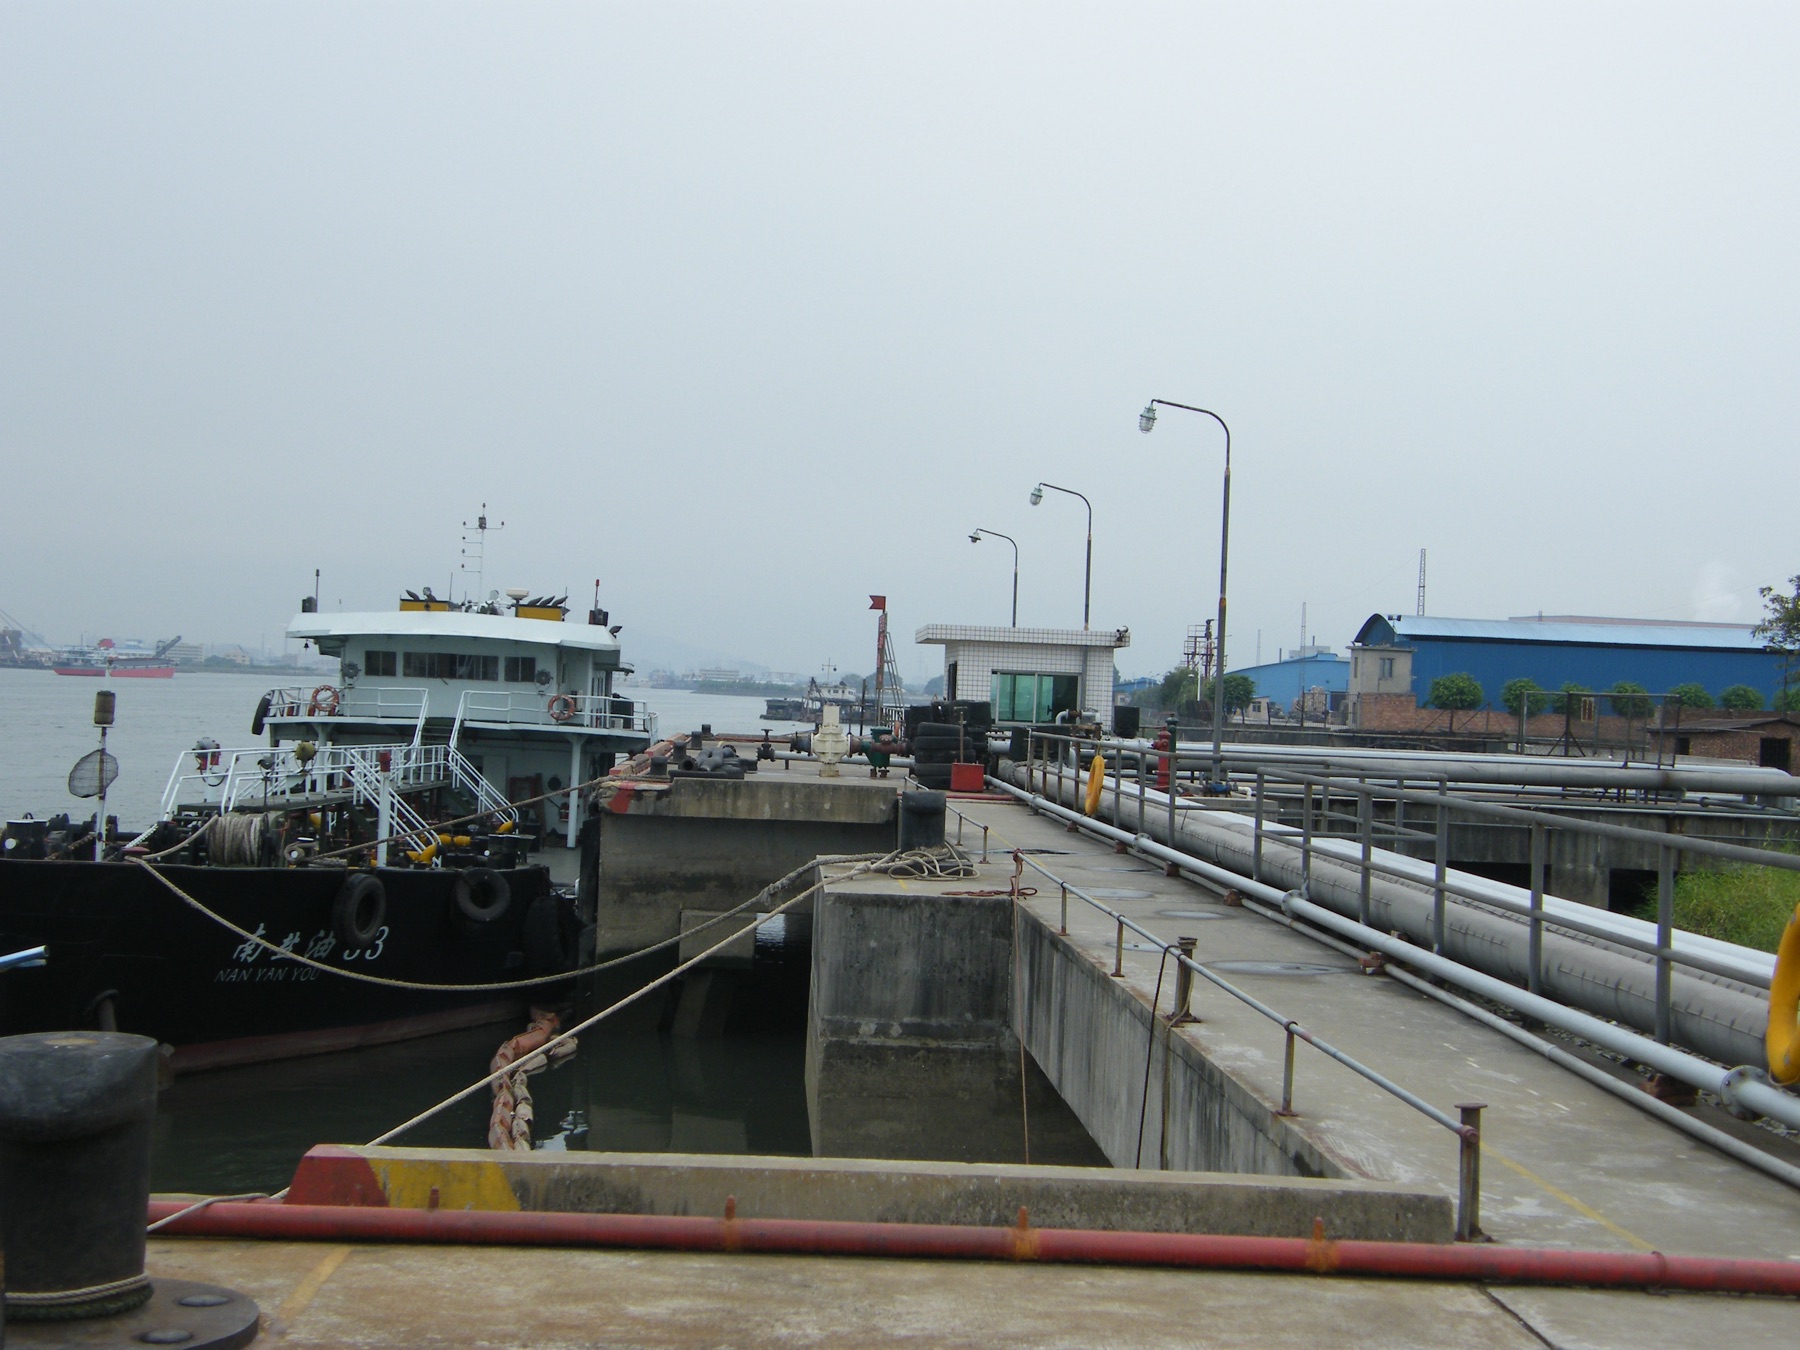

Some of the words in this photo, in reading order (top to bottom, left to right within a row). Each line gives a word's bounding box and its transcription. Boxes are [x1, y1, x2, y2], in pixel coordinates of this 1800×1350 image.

[214, 967, 254, 983] NAN
[255, 966, 289, 982] YAN
[291, 966, 321, 982] YOU
